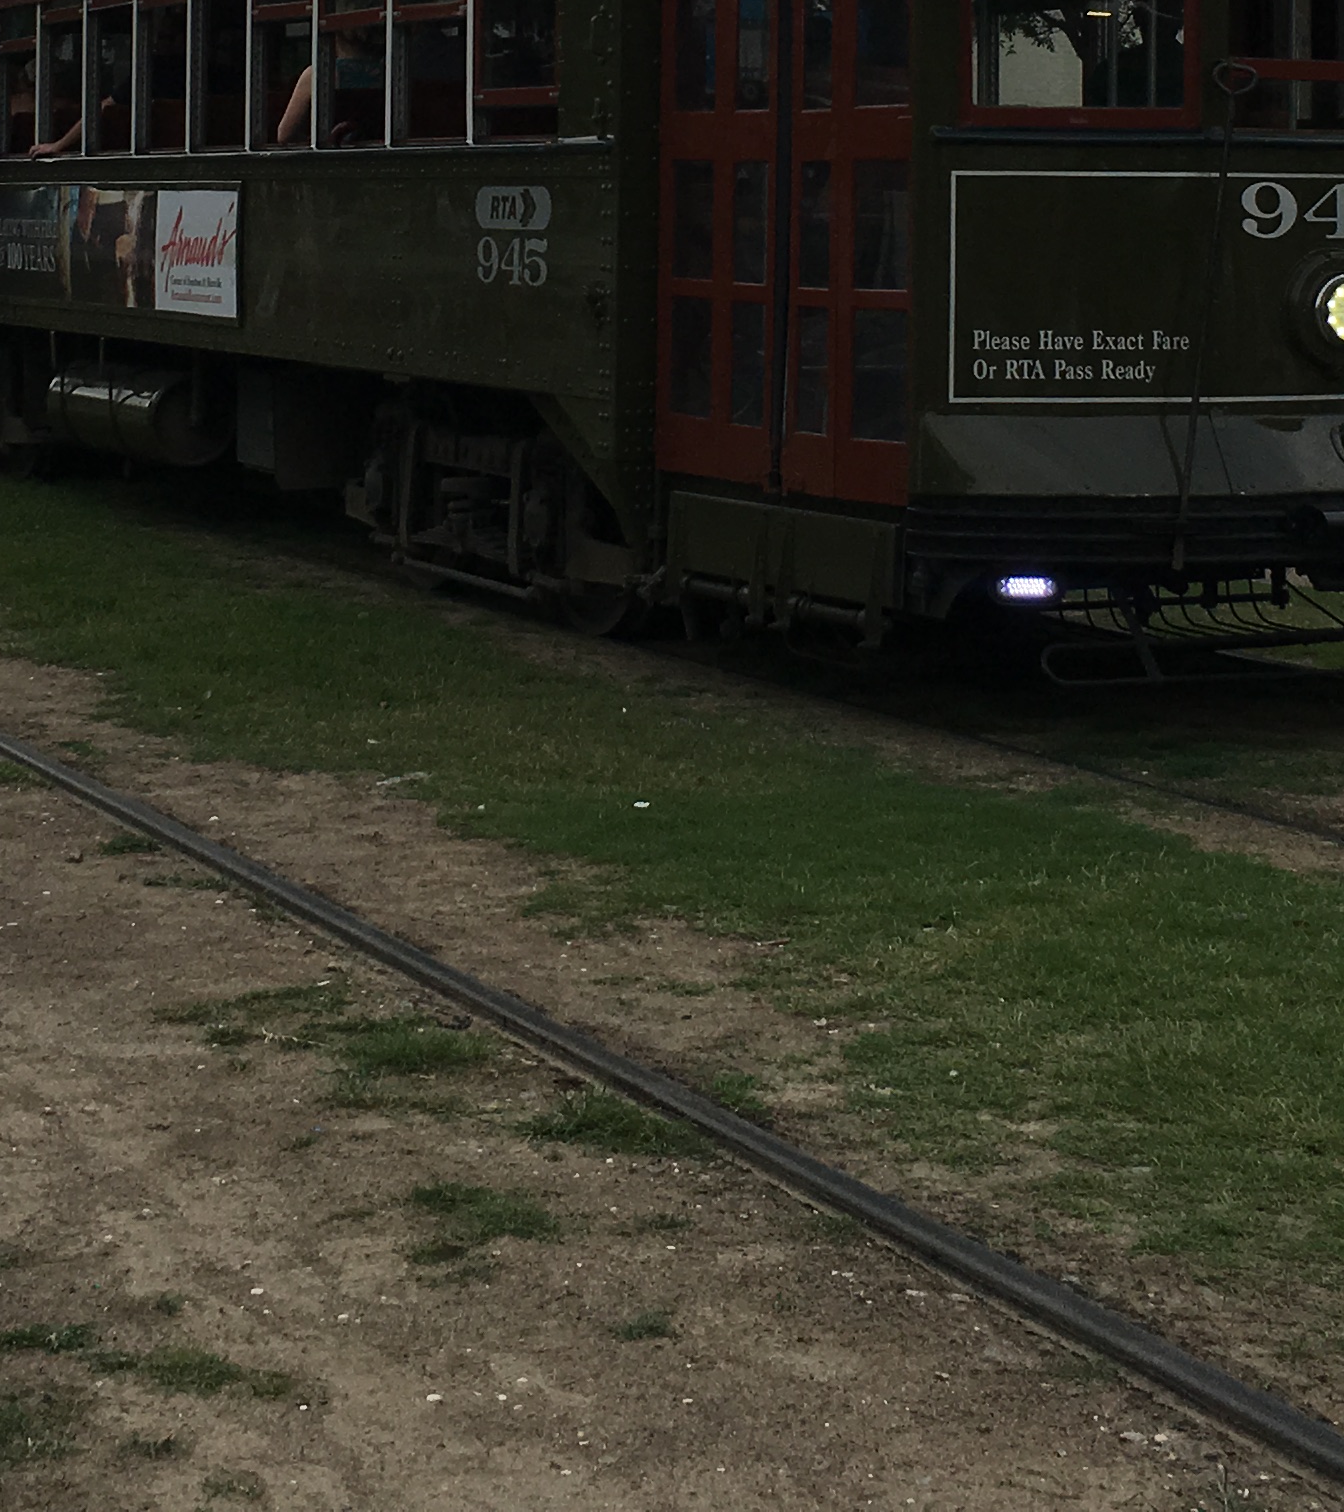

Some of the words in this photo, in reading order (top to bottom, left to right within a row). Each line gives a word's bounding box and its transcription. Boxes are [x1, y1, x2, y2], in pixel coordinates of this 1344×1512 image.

[490, 195, 517, 220] RTA
[477, 235, 548, 287] 945
[972, 329, 1030, 350] Please
[1038, 329, 1084, 350] Have
[1092, 330, 1144, 350] Exact
[1152, 330, 1190, 350] Fare
[972, 358, 997, 380] Or
[1005, 359, 1045, 380] RTA
[1054, 359, 1093, 380] Pass
[1101, 359, 1156, 384] Ready
